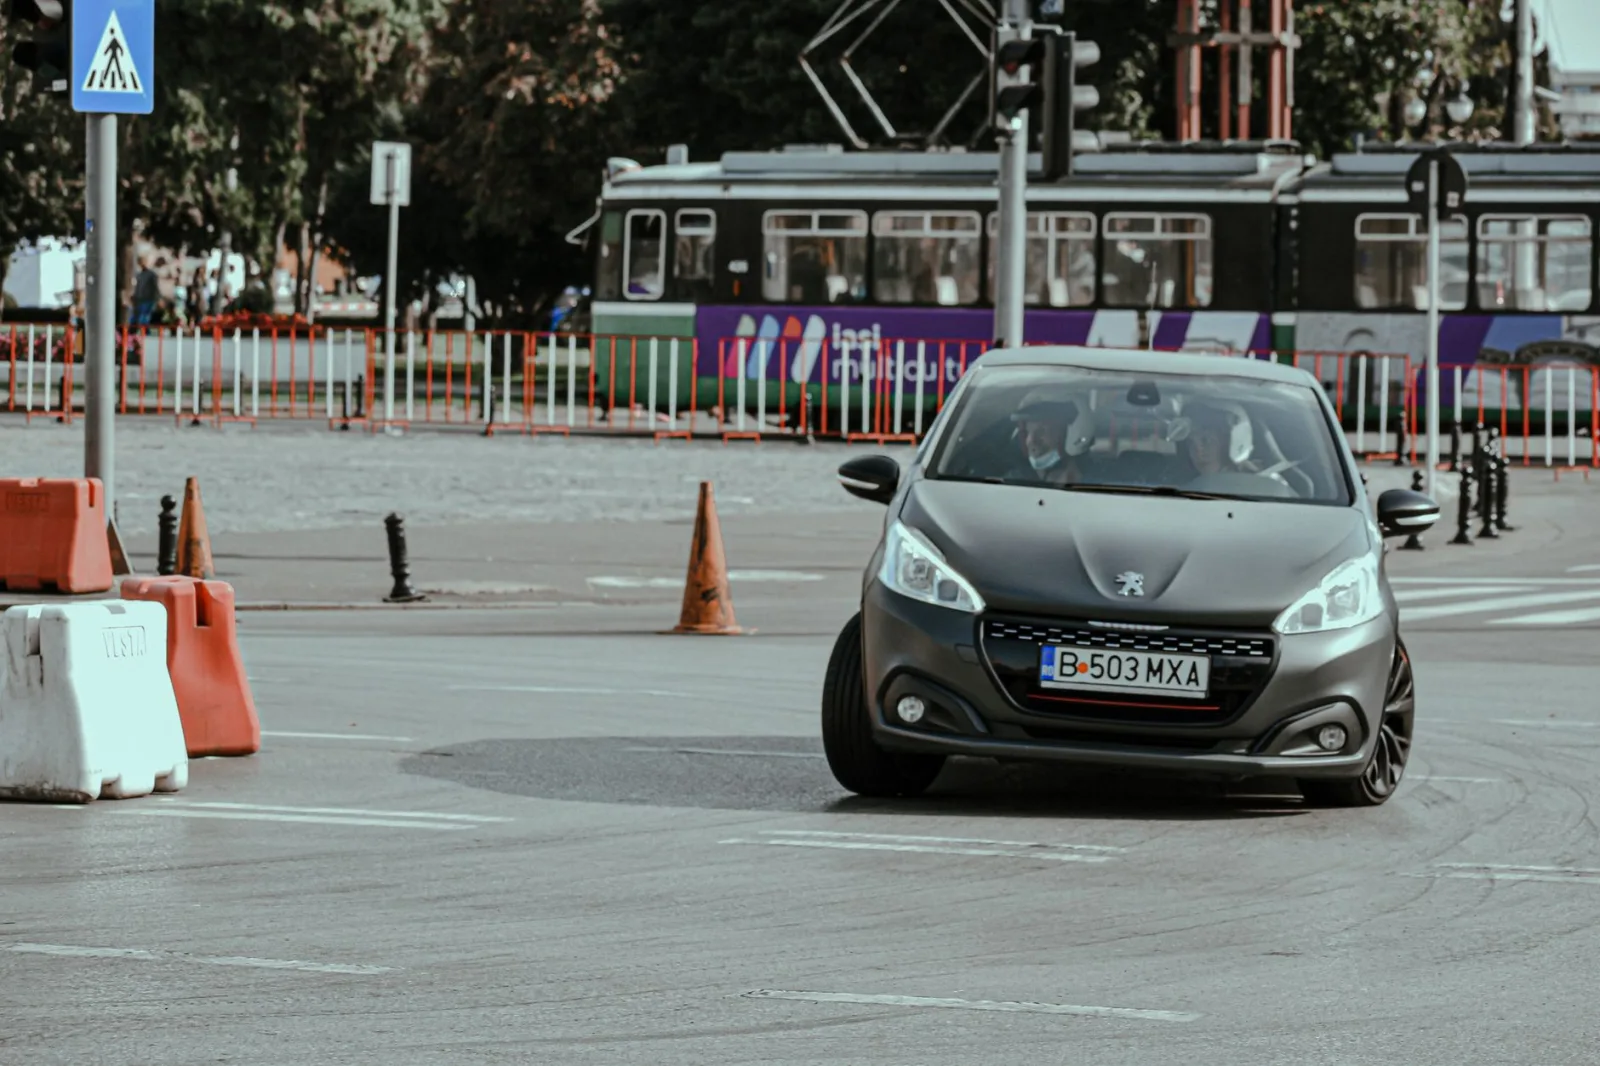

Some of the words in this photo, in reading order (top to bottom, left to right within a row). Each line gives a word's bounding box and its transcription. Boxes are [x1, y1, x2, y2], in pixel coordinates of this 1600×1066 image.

[1059, 652, 1079, 677] B
[1090, 654, 1139, 682] 503
[1146, 657, 1199, 687] MXA
